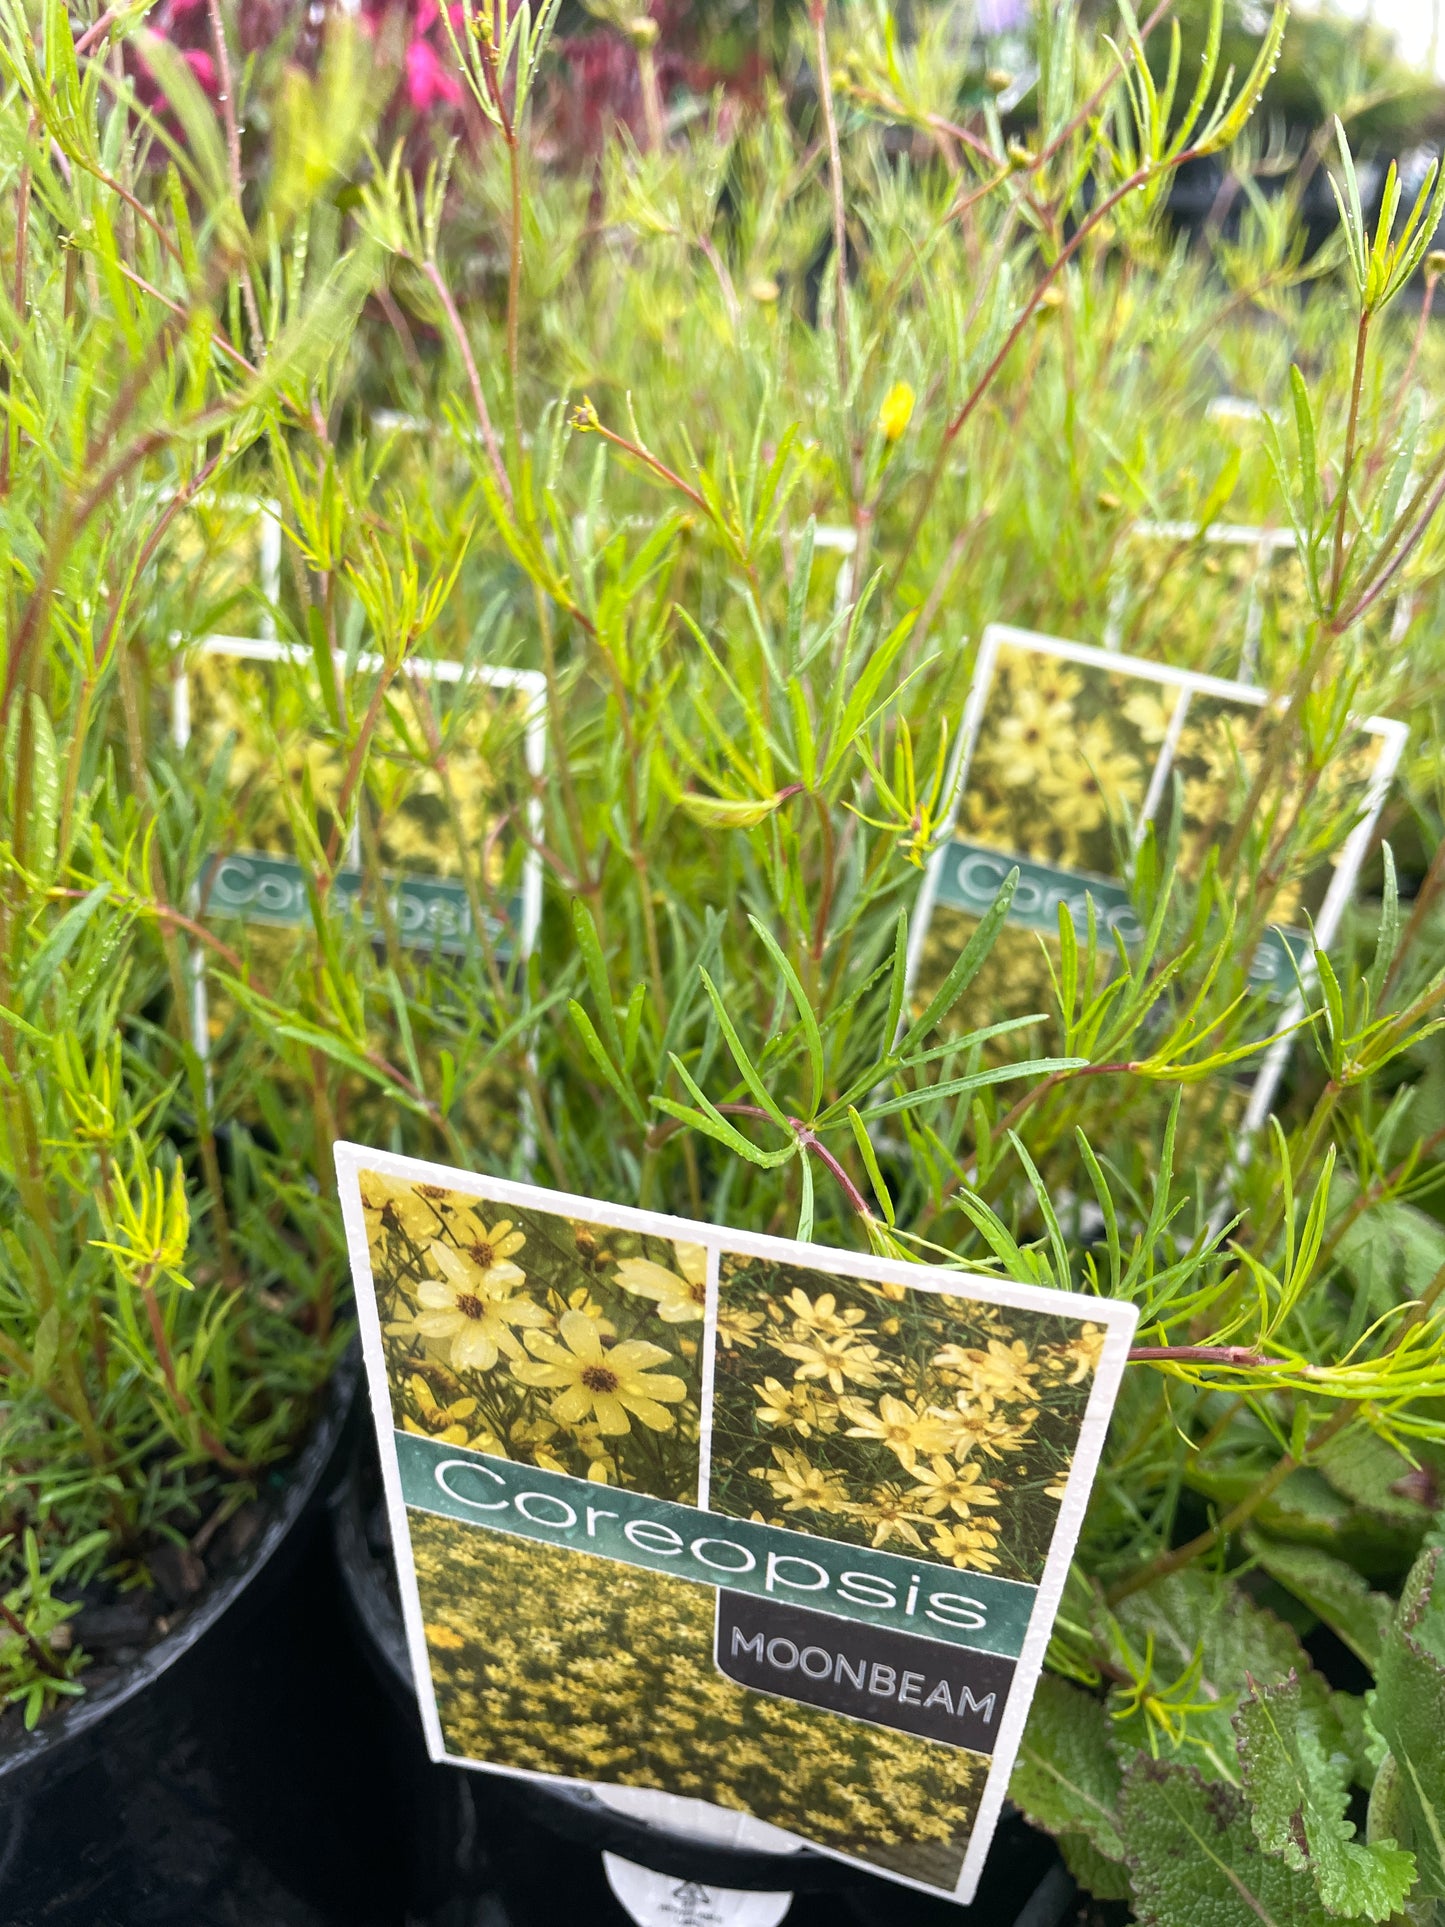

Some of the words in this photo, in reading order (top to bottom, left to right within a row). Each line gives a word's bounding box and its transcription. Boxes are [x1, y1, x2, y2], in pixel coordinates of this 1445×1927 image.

[956, 853, 1280, 980] Coreos
[433, 1459, 989, 1628] Coreopsis
[730, 1626, 998, 1725] MOONBEAM
